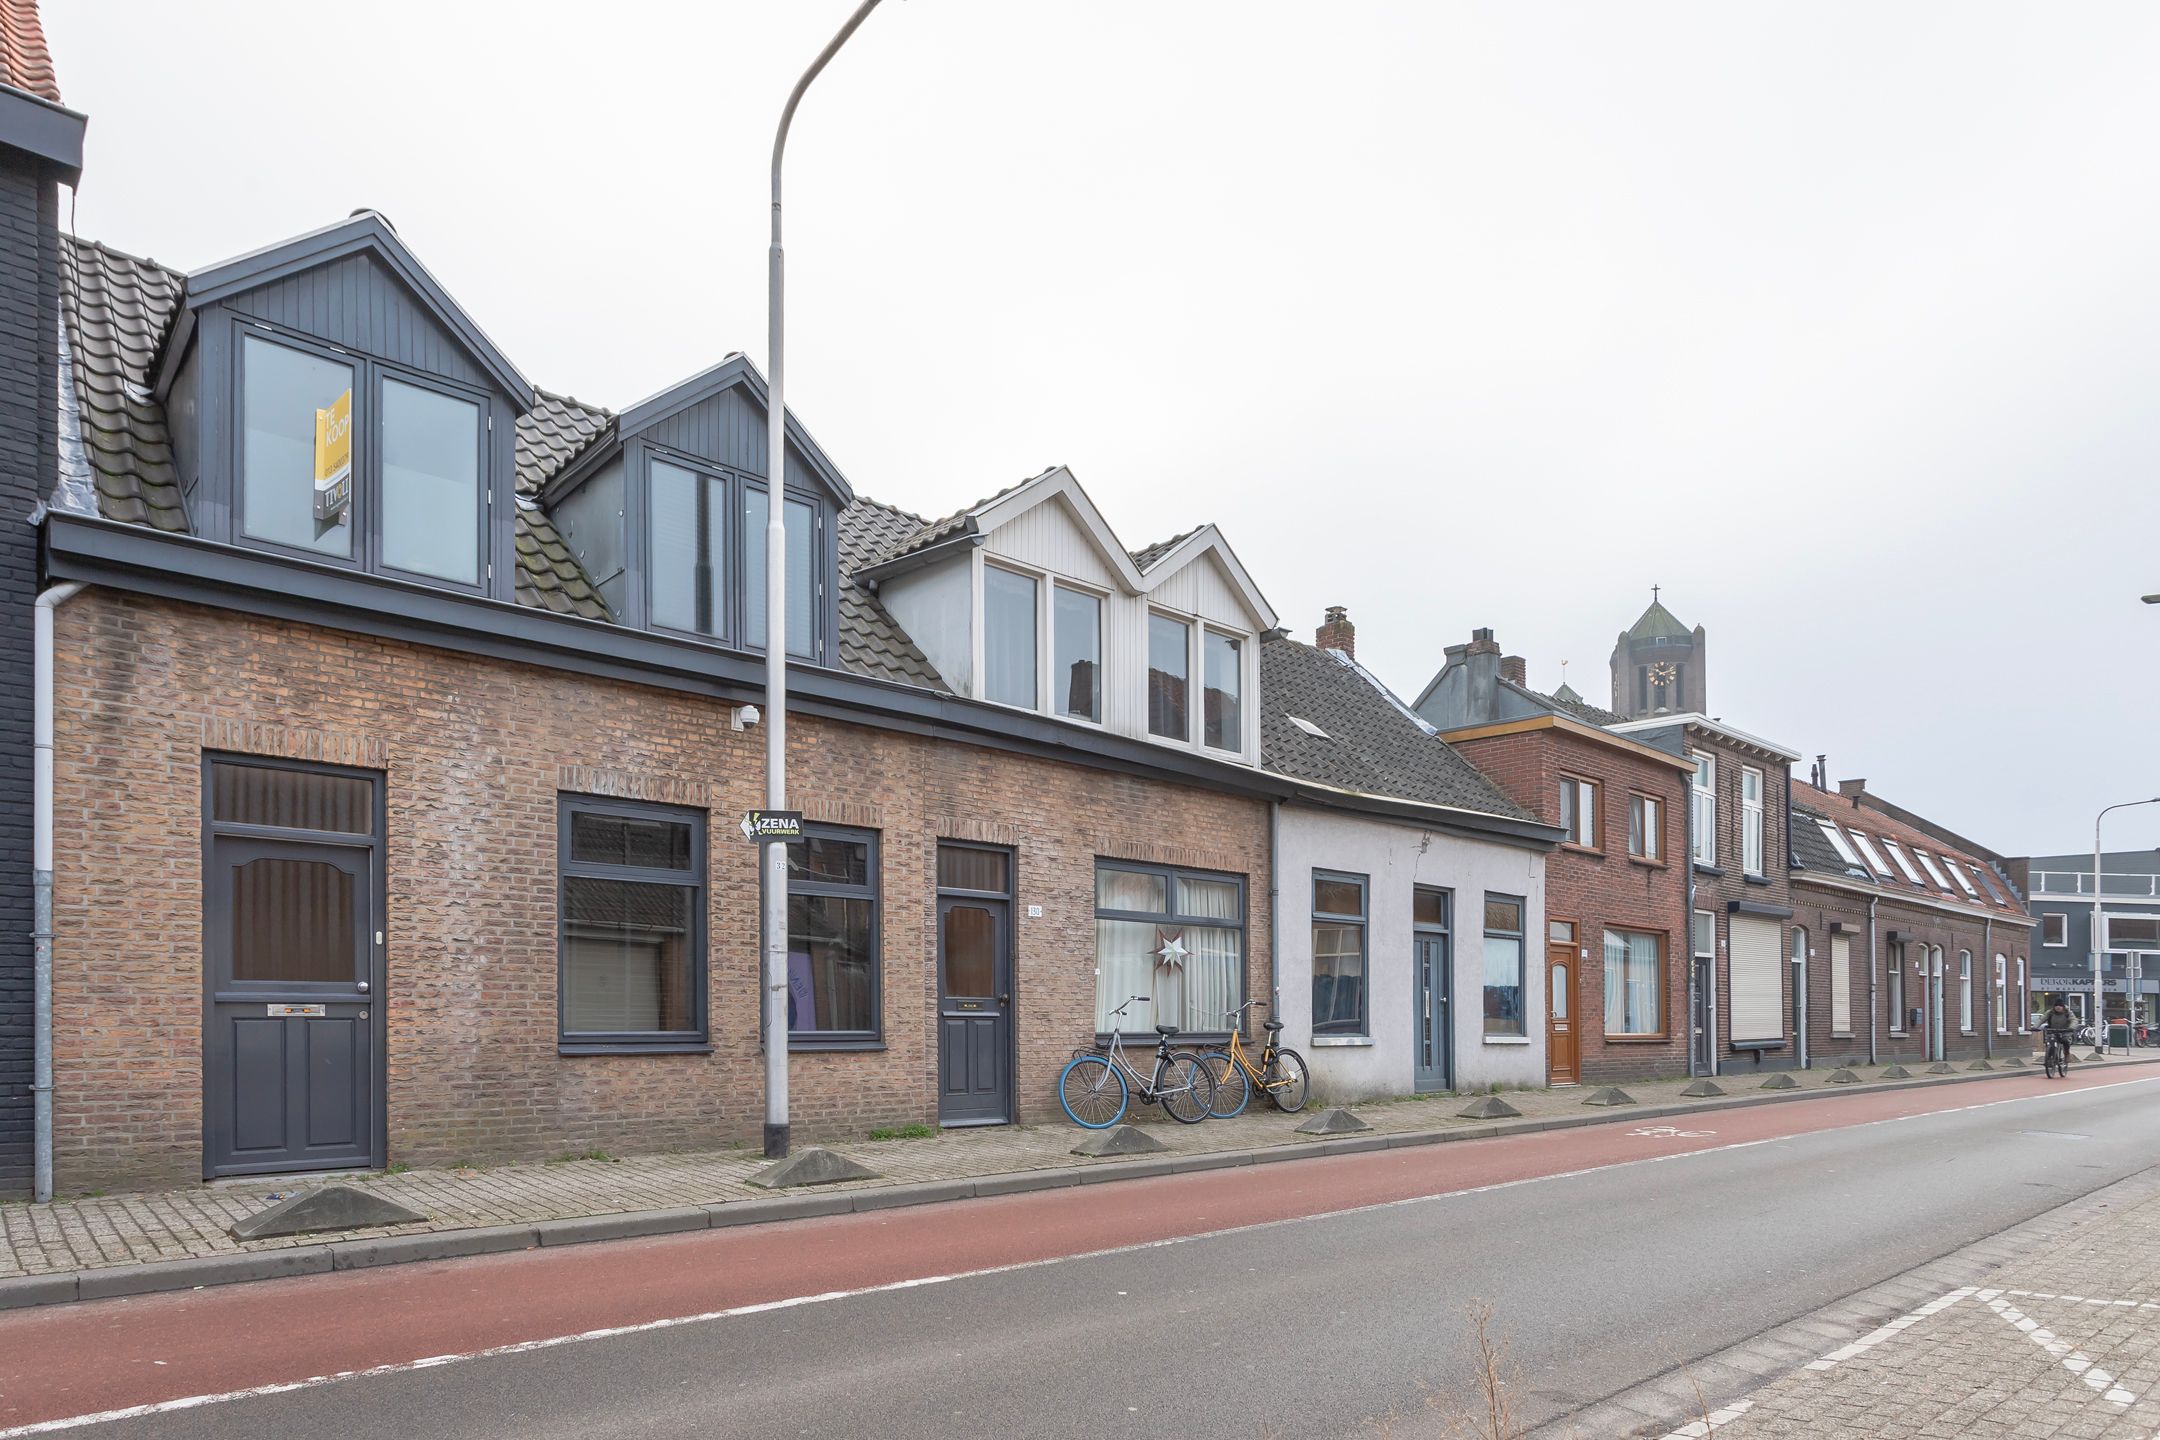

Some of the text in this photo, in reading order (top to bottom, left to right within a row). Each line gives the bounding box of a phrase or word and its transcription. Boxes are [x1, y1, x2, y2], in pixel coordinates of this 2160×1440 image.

[325, 407, 335, 429] TE
[326, 415, 349, 447] KOOP
[325, 478, 349, 507] TIVOLI
[761, 818, 799, 829] ZENA
